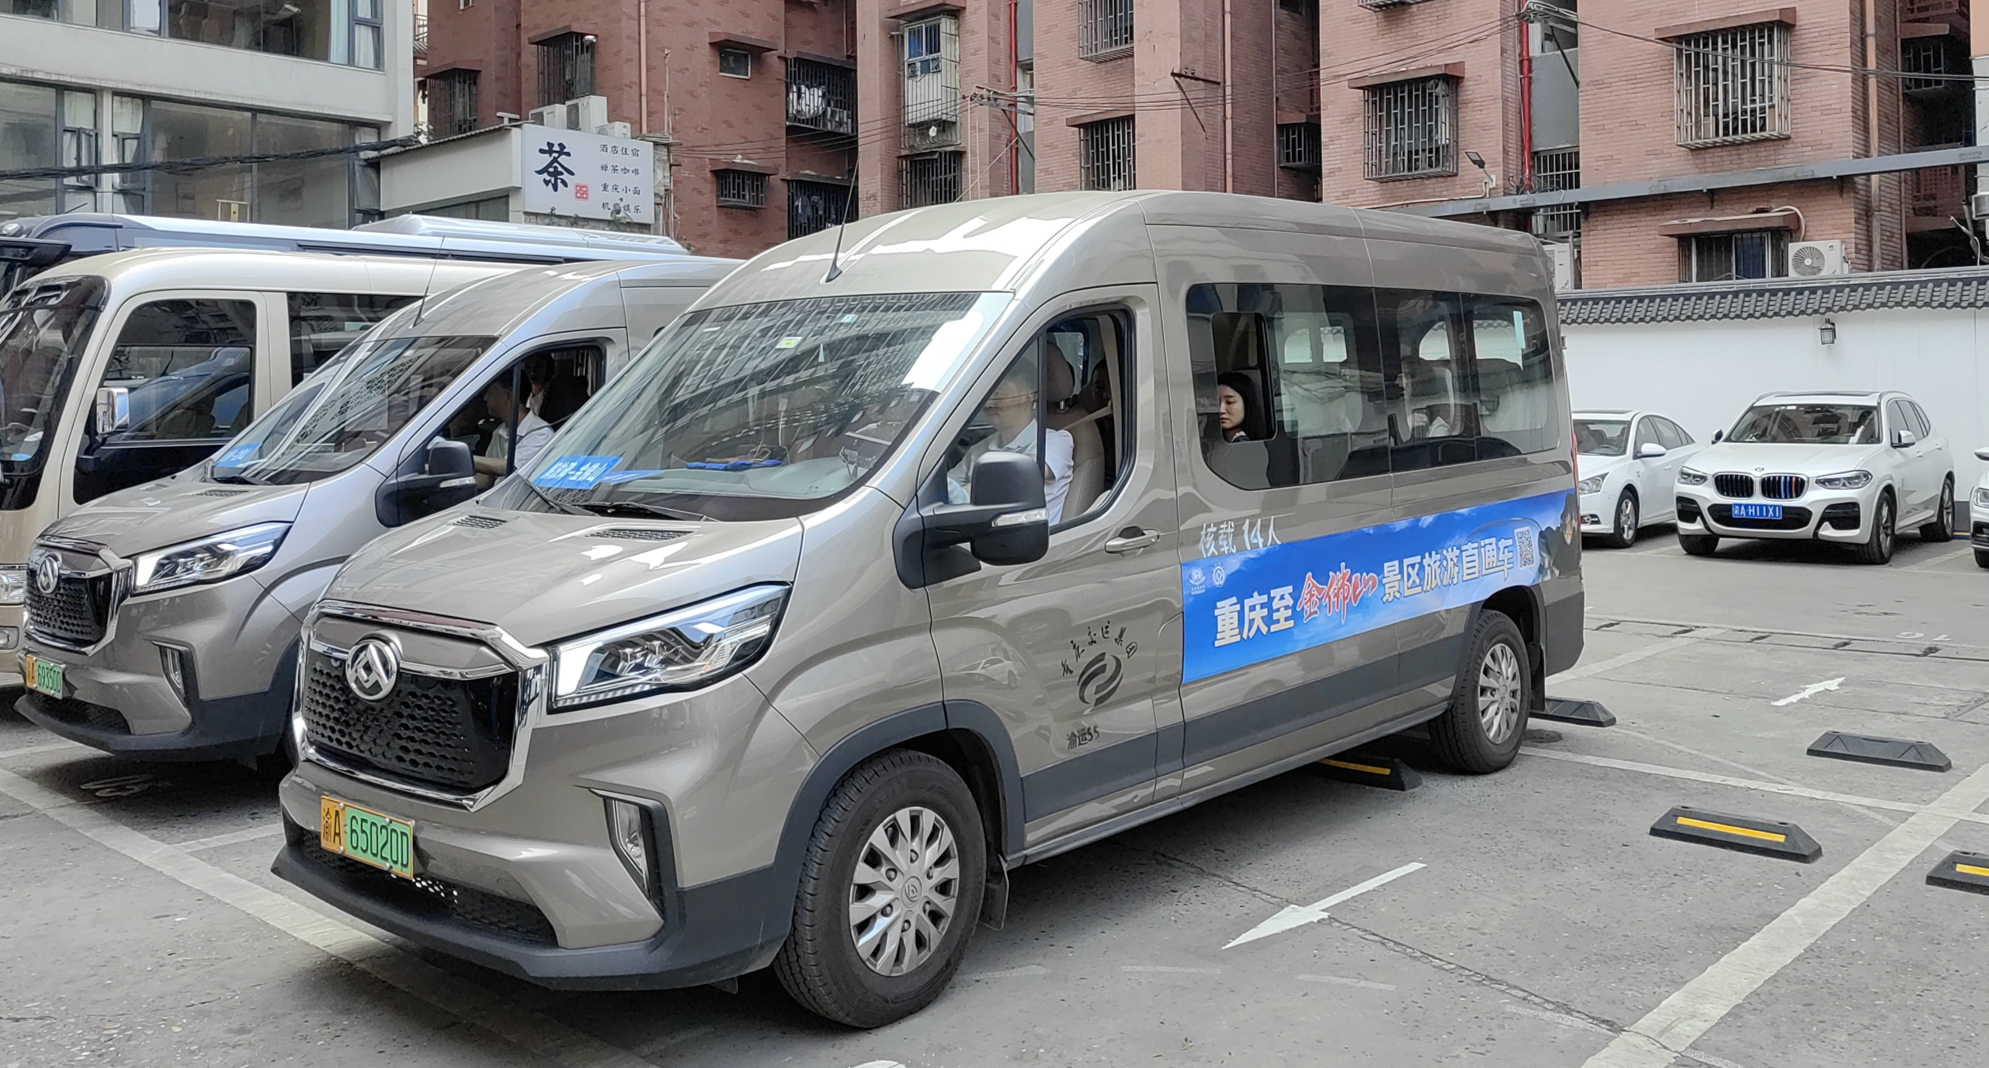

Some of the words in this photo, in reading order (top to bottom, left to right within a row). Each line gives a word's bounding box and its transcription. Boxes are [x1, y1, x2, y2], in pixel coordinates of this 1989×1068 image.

[599, 143, 640, 158] 酒店住宿
[534, 141, 576, 192] 茶
[601, 182, 641, 196] 重庆小面
